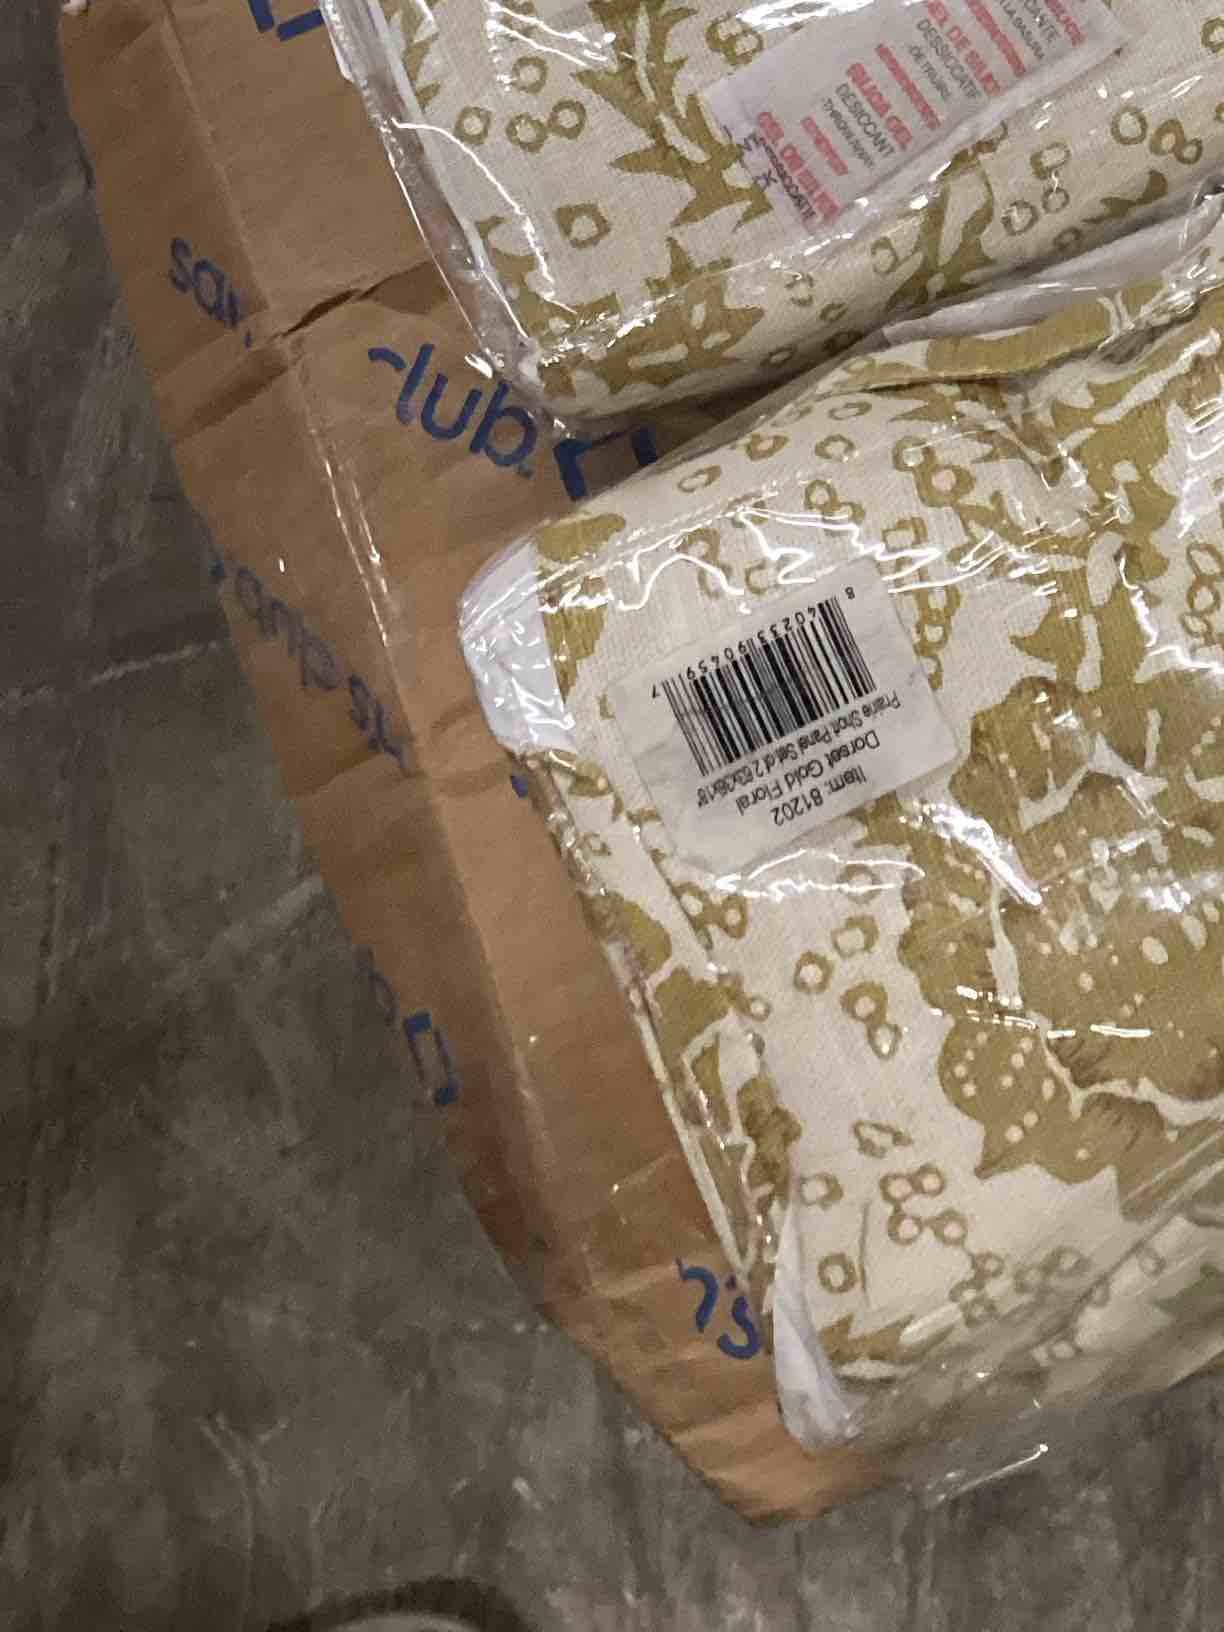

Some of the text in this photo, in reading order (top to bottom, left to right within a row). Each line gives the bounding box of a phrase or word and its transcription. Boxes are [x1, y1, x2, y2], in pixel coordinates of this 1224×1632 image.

[834, 82, 895, 158] DESICCANT
[829, 709, 862, 737] Short
[775, 742, 798, 765] Set
[796, 725, 832, 754] Panel
[735, 729, 879, 815] Dorset Gold Floral
[761, 752, 778, 772] of
[770, 765, 867, 825] Item: 81202
